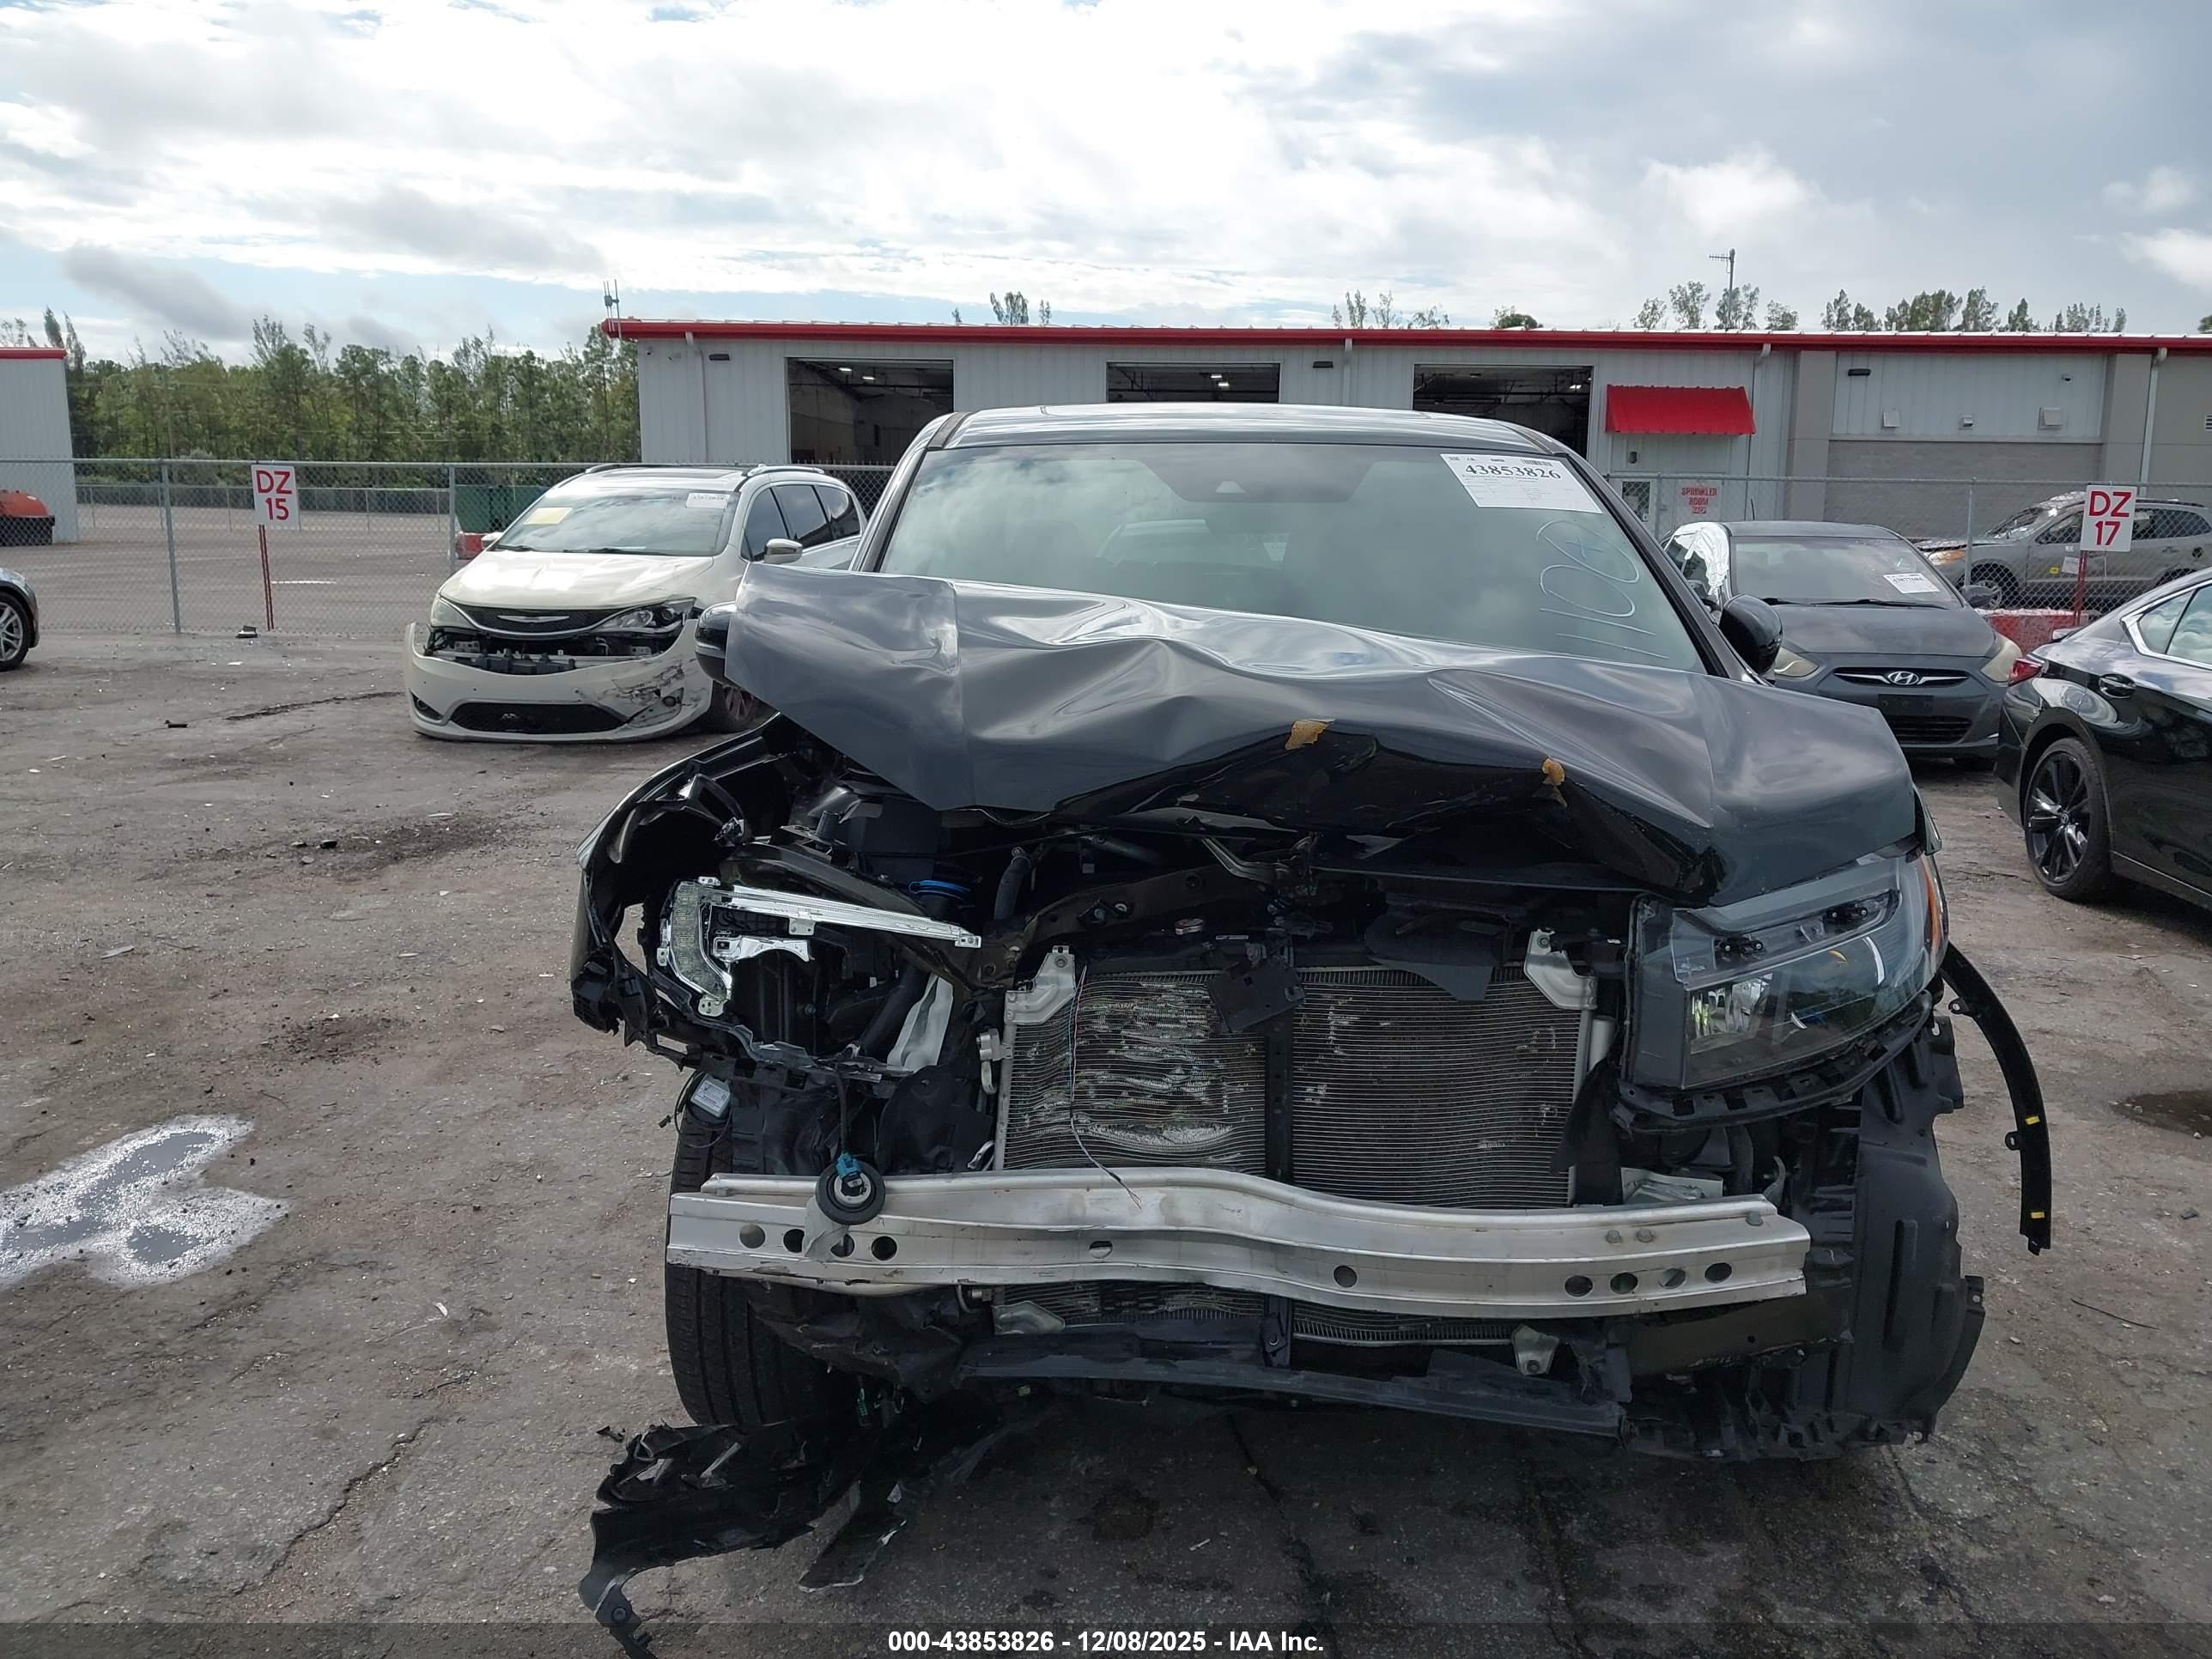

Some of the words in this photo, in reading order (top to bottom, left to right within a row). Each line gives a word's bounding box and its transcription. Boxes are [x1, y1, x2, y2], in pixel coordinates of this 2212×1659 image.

[256, 470, 293, 494] DZ
[1465, 465, 1562, 480] 43853826
[265, 497, 289, 520] 15
[2088, 490, 2131, 517] DZ
[2095, 520, 2121, 545] 17
